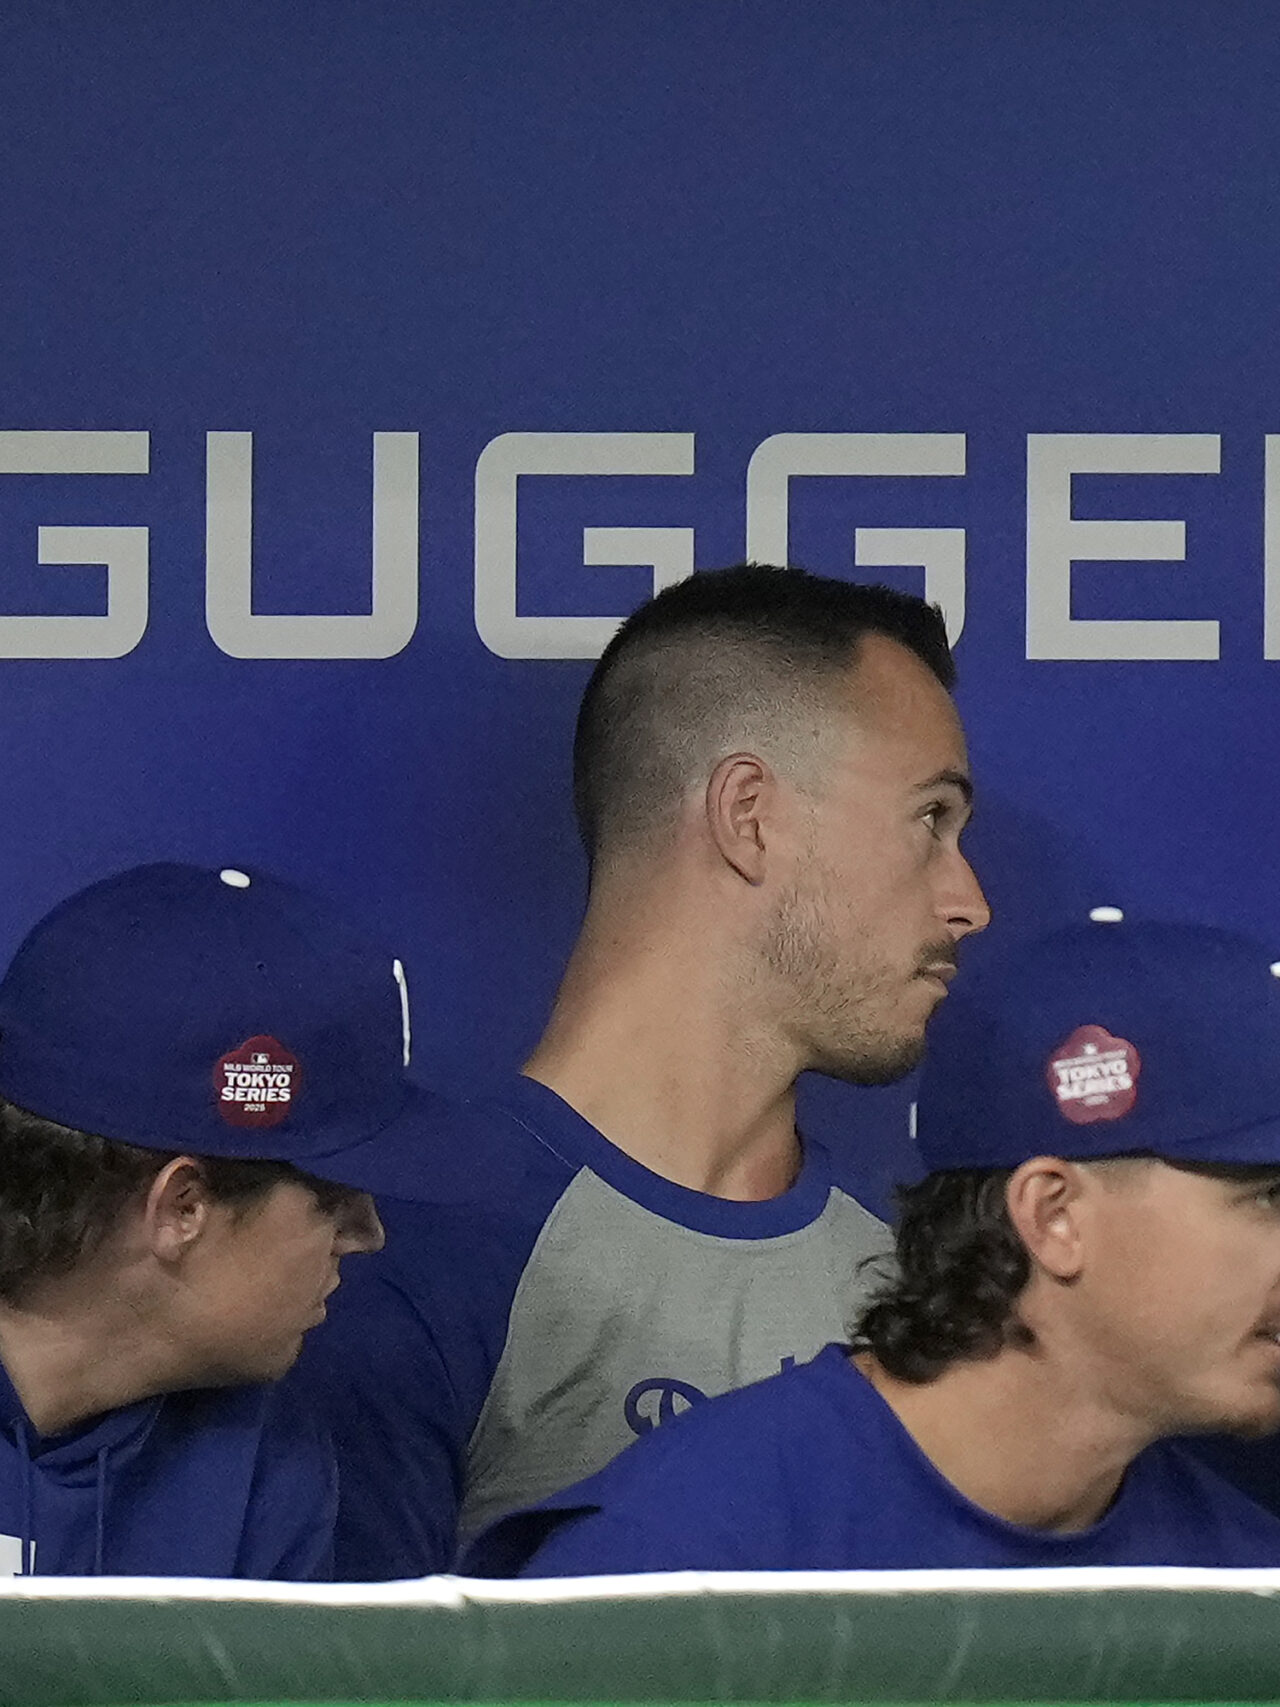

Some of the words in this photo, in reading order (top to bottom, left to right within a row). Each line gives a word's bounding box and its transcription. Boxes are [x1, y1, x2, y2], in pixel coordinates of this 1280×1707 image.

[224, 1072, 290, 1087] TOKYO
[1057, 1059, 1128, 1084] TOKYO
[220, 1086, 291, 1102] SERIES
